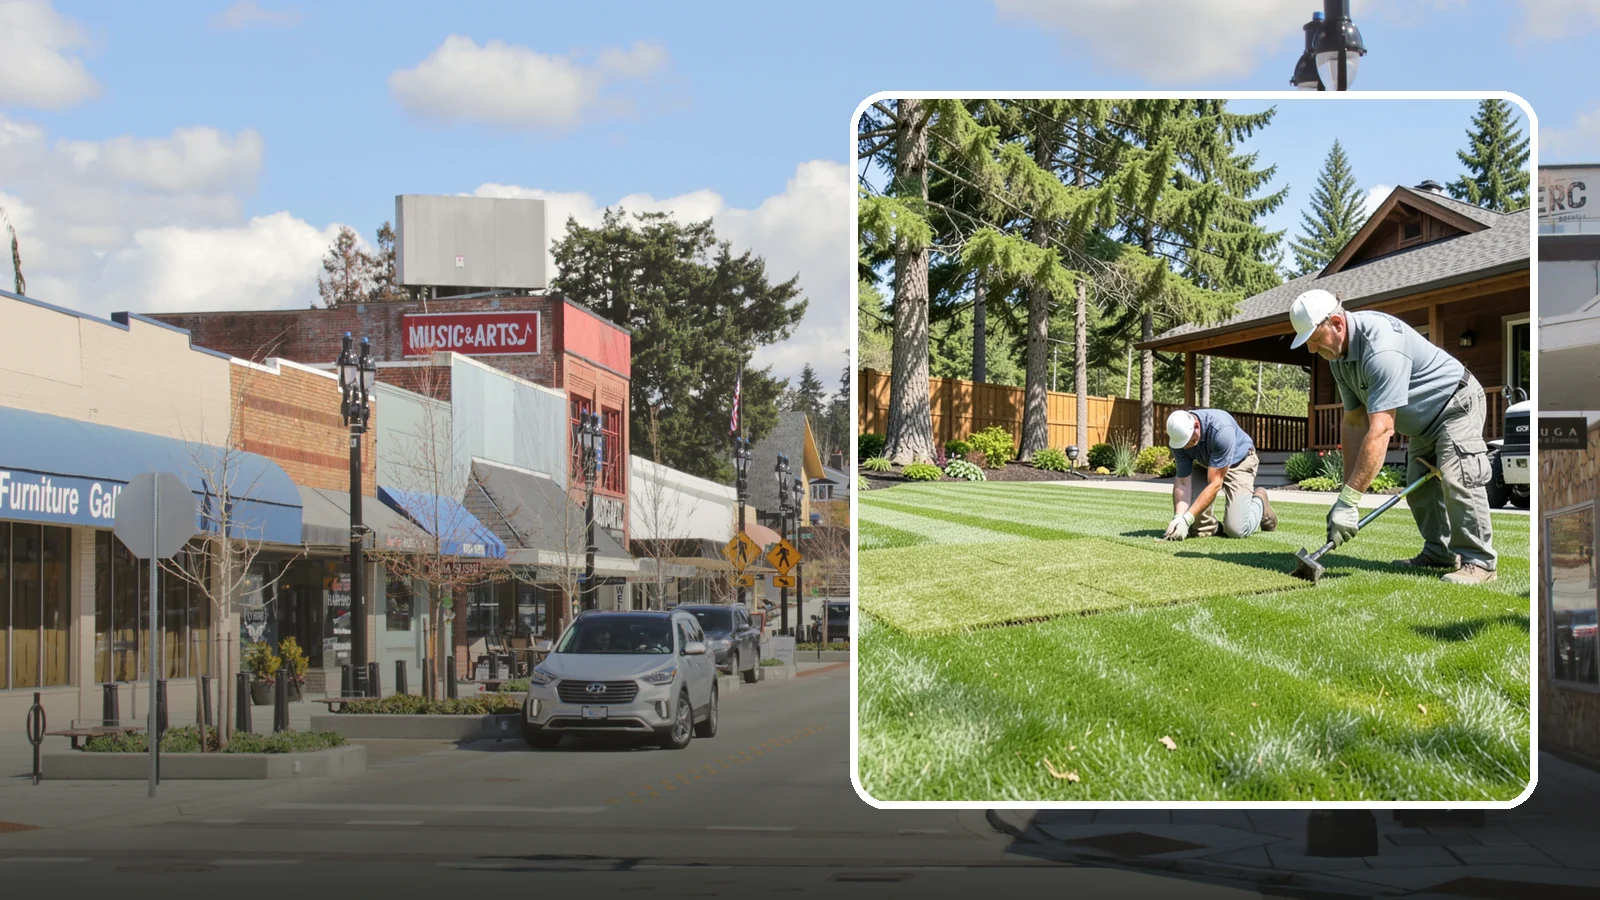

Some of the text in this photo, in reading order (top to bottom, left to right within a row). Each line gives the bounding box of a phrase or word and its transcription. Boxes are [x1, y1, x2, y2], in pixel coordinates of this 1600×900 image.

[409, 323, 520, 349] MUSIC&ARTS
[1540, 428, 1577, 436] UGA
[0, 471, 121, 519] Furniture Gal
